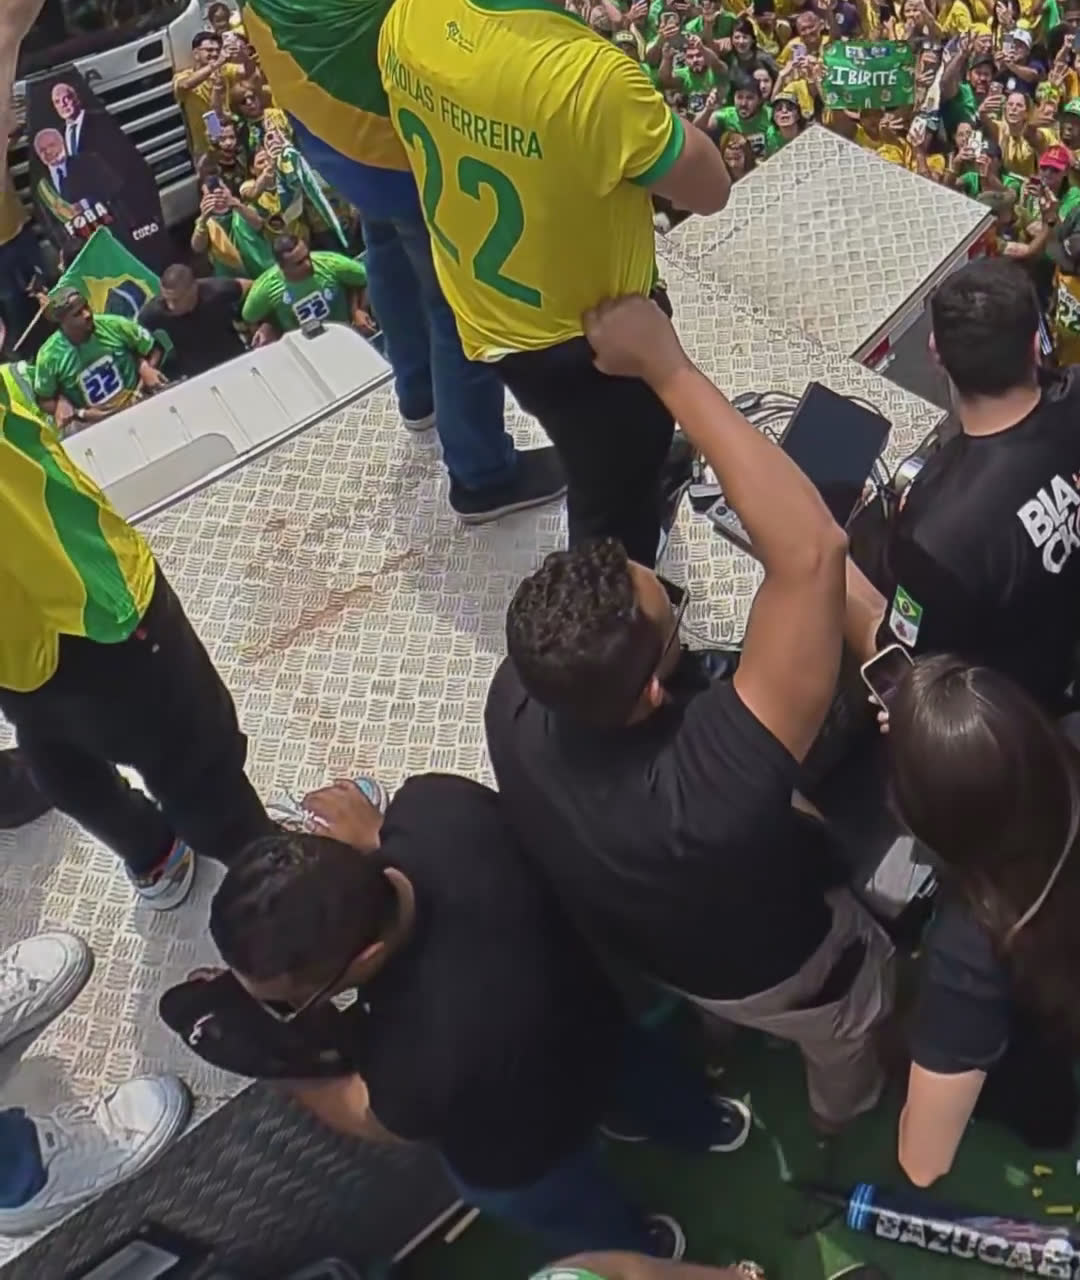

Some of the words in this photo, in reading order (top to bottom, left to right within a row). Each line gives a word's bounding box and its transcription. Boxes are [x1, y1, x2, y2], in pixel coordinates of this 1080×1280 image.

[385, 45, 435, 113] NKOLAS
[440, 95, 543, 160] FERREIRA
[397, 108, 542, 308] 22
[85, 365, 120, 404] 22
[1016, 473, 1080, 548] BLA
[875, 1212, 1034, 1272] BAZUCA
